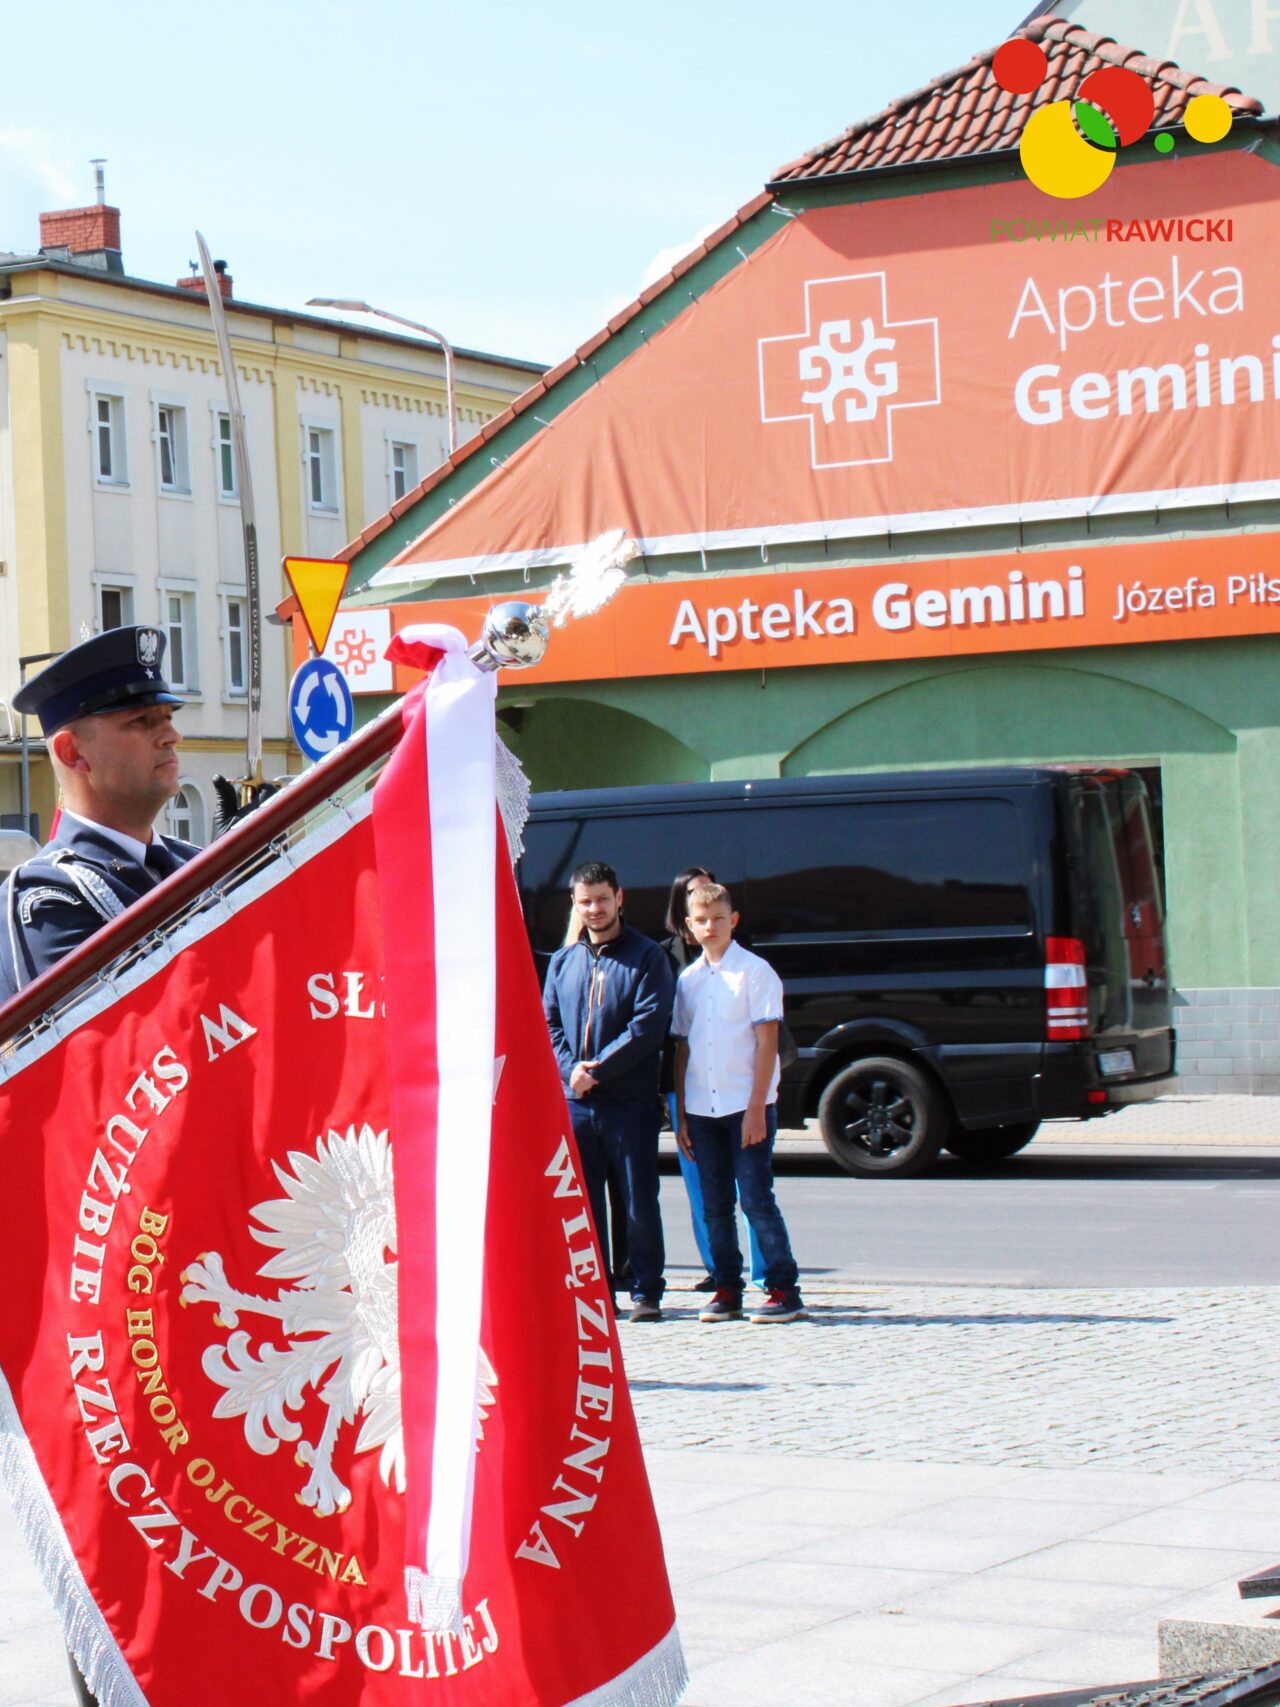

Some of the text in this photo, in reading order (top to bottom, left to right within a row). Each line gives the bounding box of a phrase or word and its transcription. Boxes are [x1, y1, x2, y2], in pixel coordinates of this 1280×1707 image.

[1008, 255, 1244, 352] Apteka
[669, 588, 855, 657] Apteka
[872, 565, 1085, 631] Gemini
[1113, 576, 1216, 620] Józefa
[67, 1002, 499, 1679] W SŁUŻBIE RZECZYPOSPOLITEJ
[126, 1205, 368, 1586] BÓG HONOR OJCZYZNA
[515, 1134, 614, 1569] WIĘZIENNA
